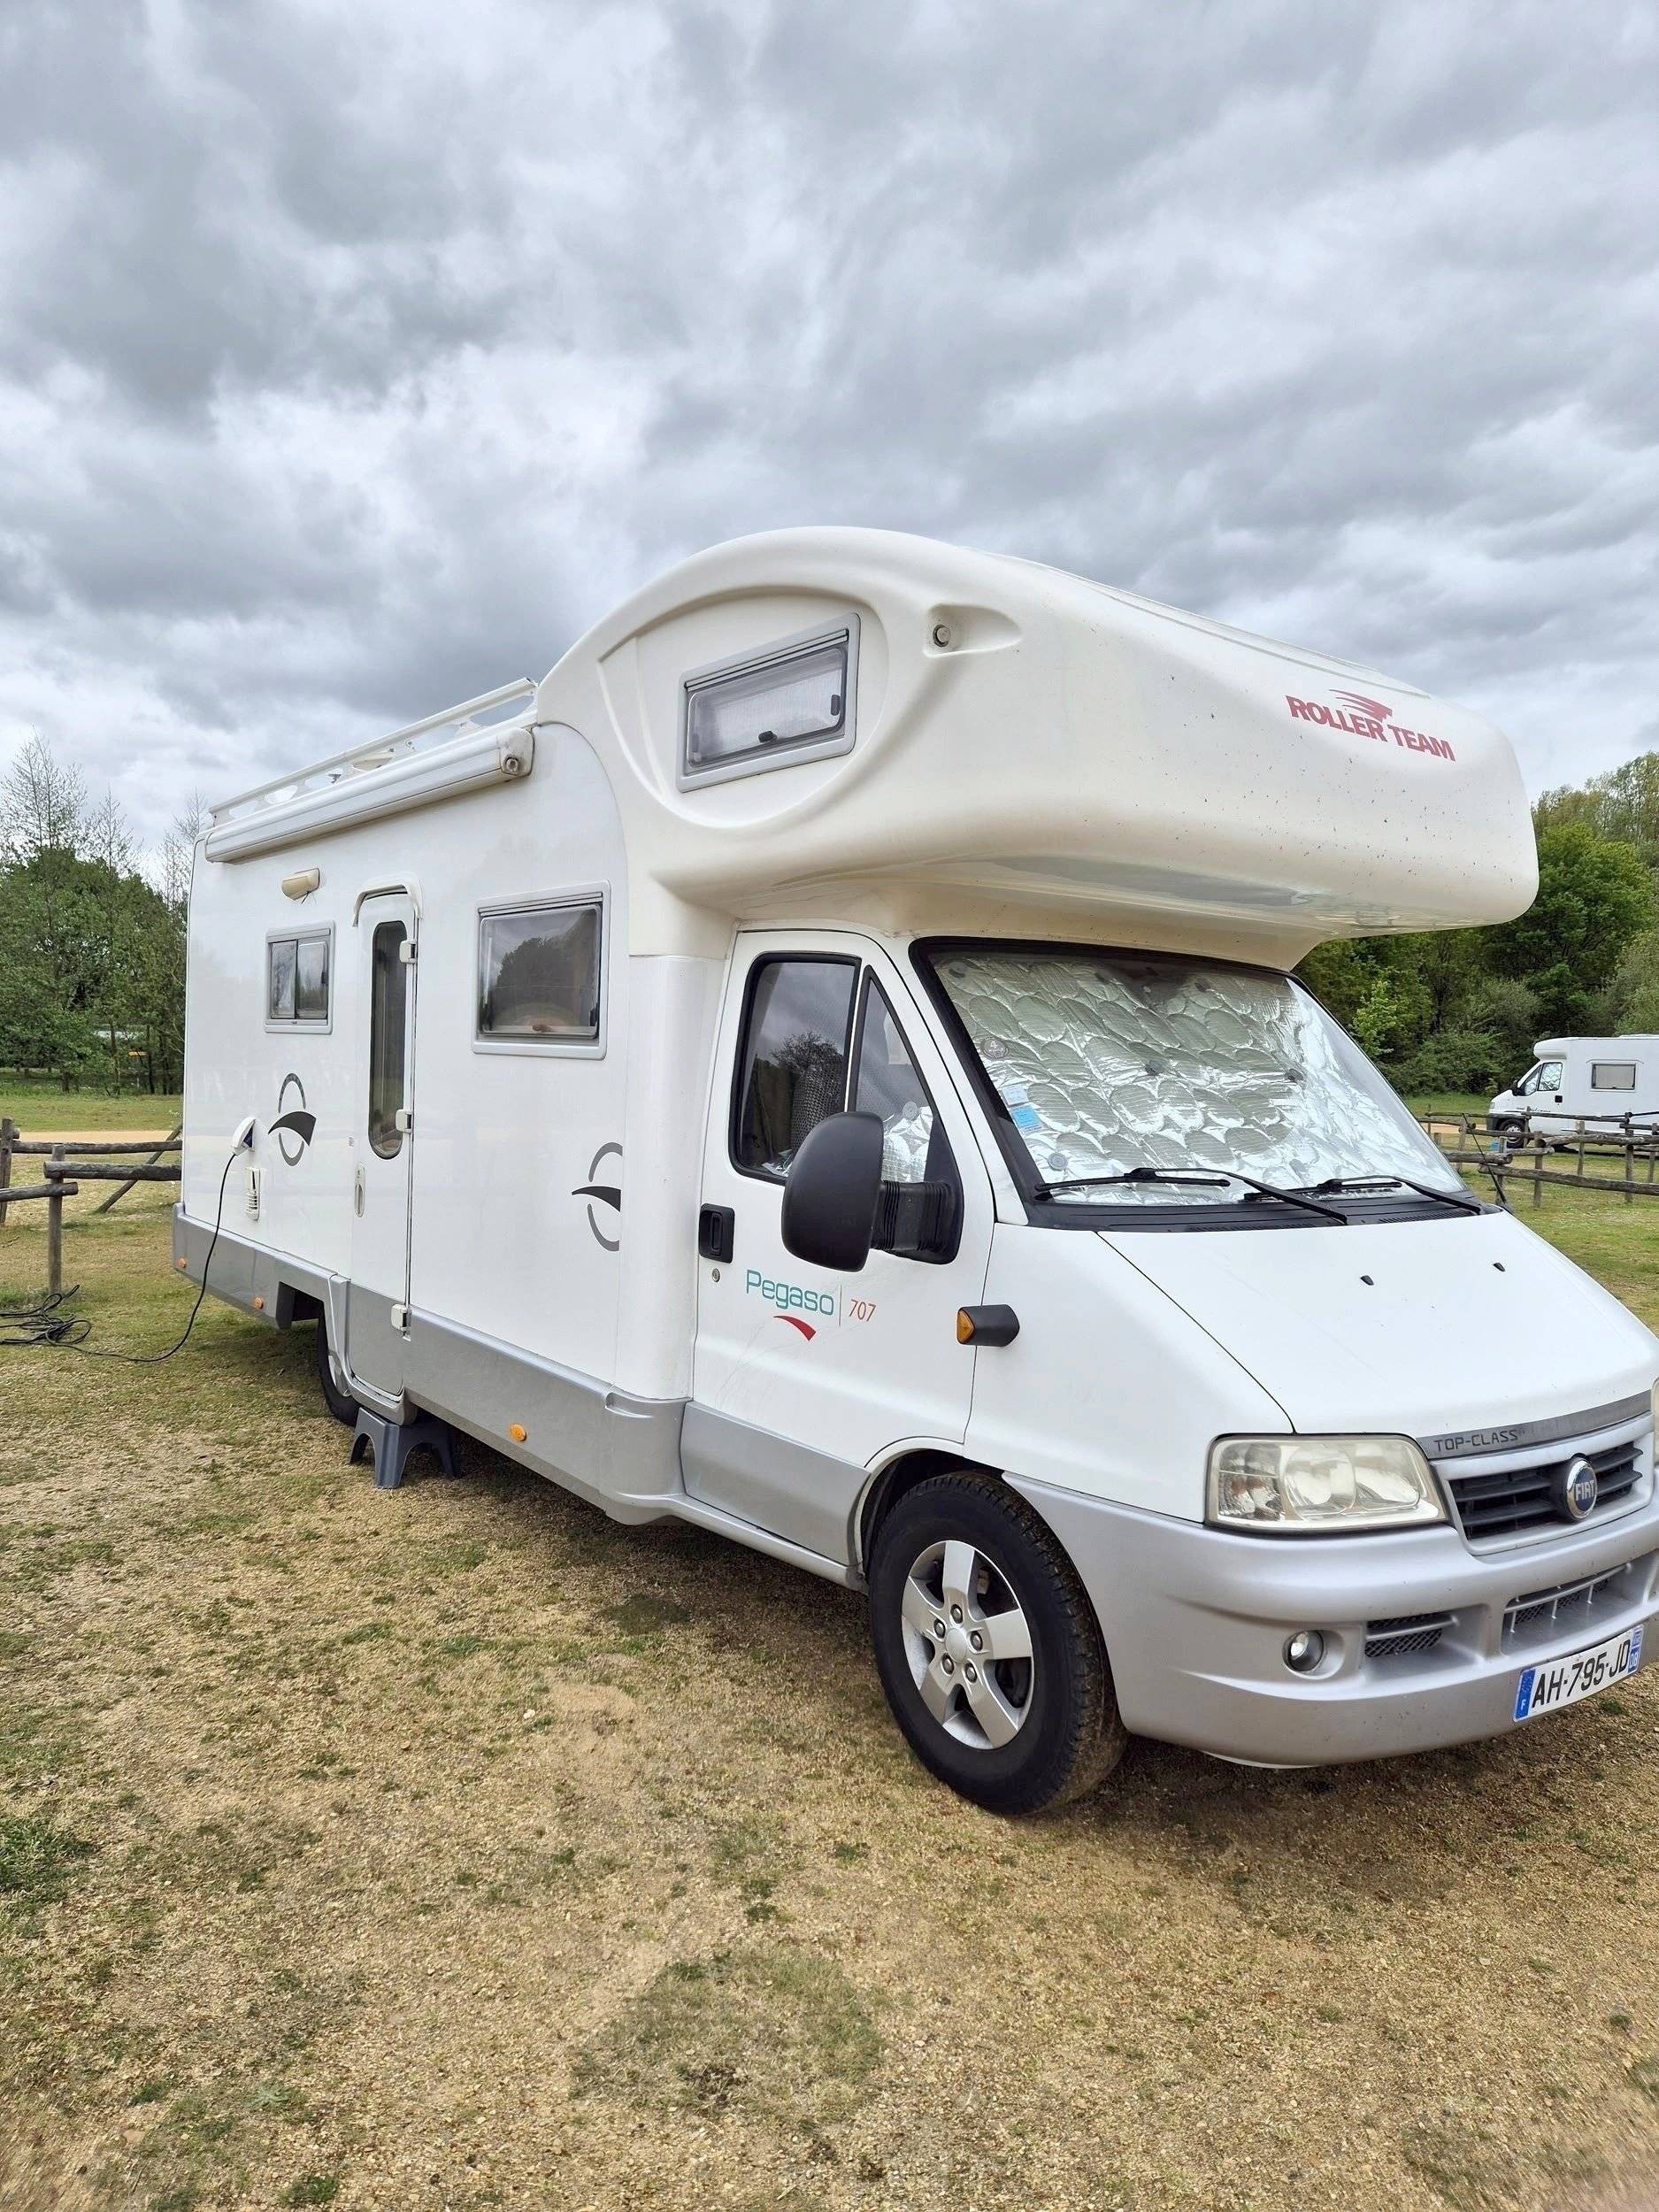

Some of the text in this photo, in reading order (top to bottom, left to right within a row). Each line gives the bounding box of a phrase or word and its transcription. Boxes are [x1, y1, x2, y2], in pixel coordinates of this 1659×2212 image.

[1286, 695, 1455, 762] ROLLER TEAM
[746, 1269, 877, 1322] Pegaso 707
[1433, 1429, 1518, 1452] TOP-CLASS
[1575, 1479, 1594, 1502] FIAT
[1520, 1699, 1527, 1710] F
[1532, 1639, 1631, 1709] AH-795-JD
